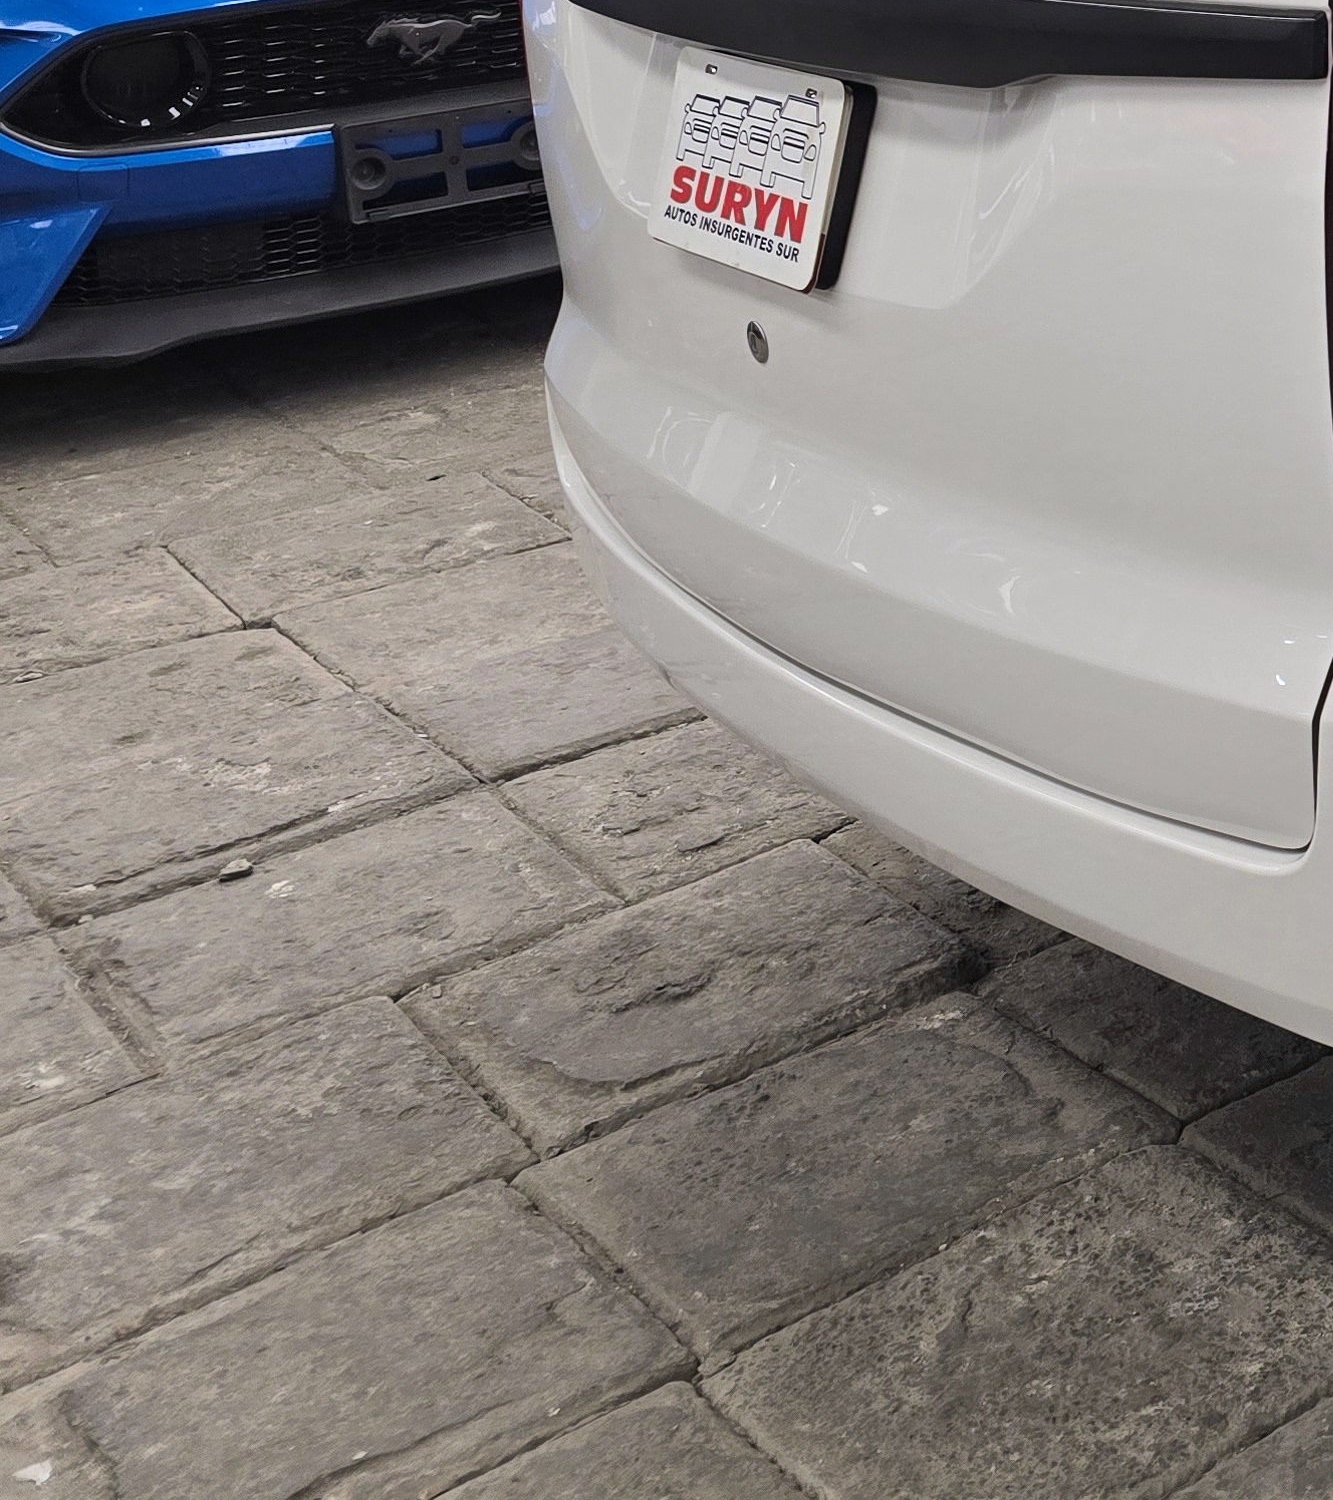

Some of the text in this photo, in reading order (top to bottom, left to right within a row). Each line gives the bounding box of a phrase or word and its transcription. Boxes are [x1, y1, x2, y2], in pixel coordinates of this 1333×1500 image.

[664, 205, 799, 262] AUTOS INSURGENTES SUR
[670, 165, 808, 243] SURYN
